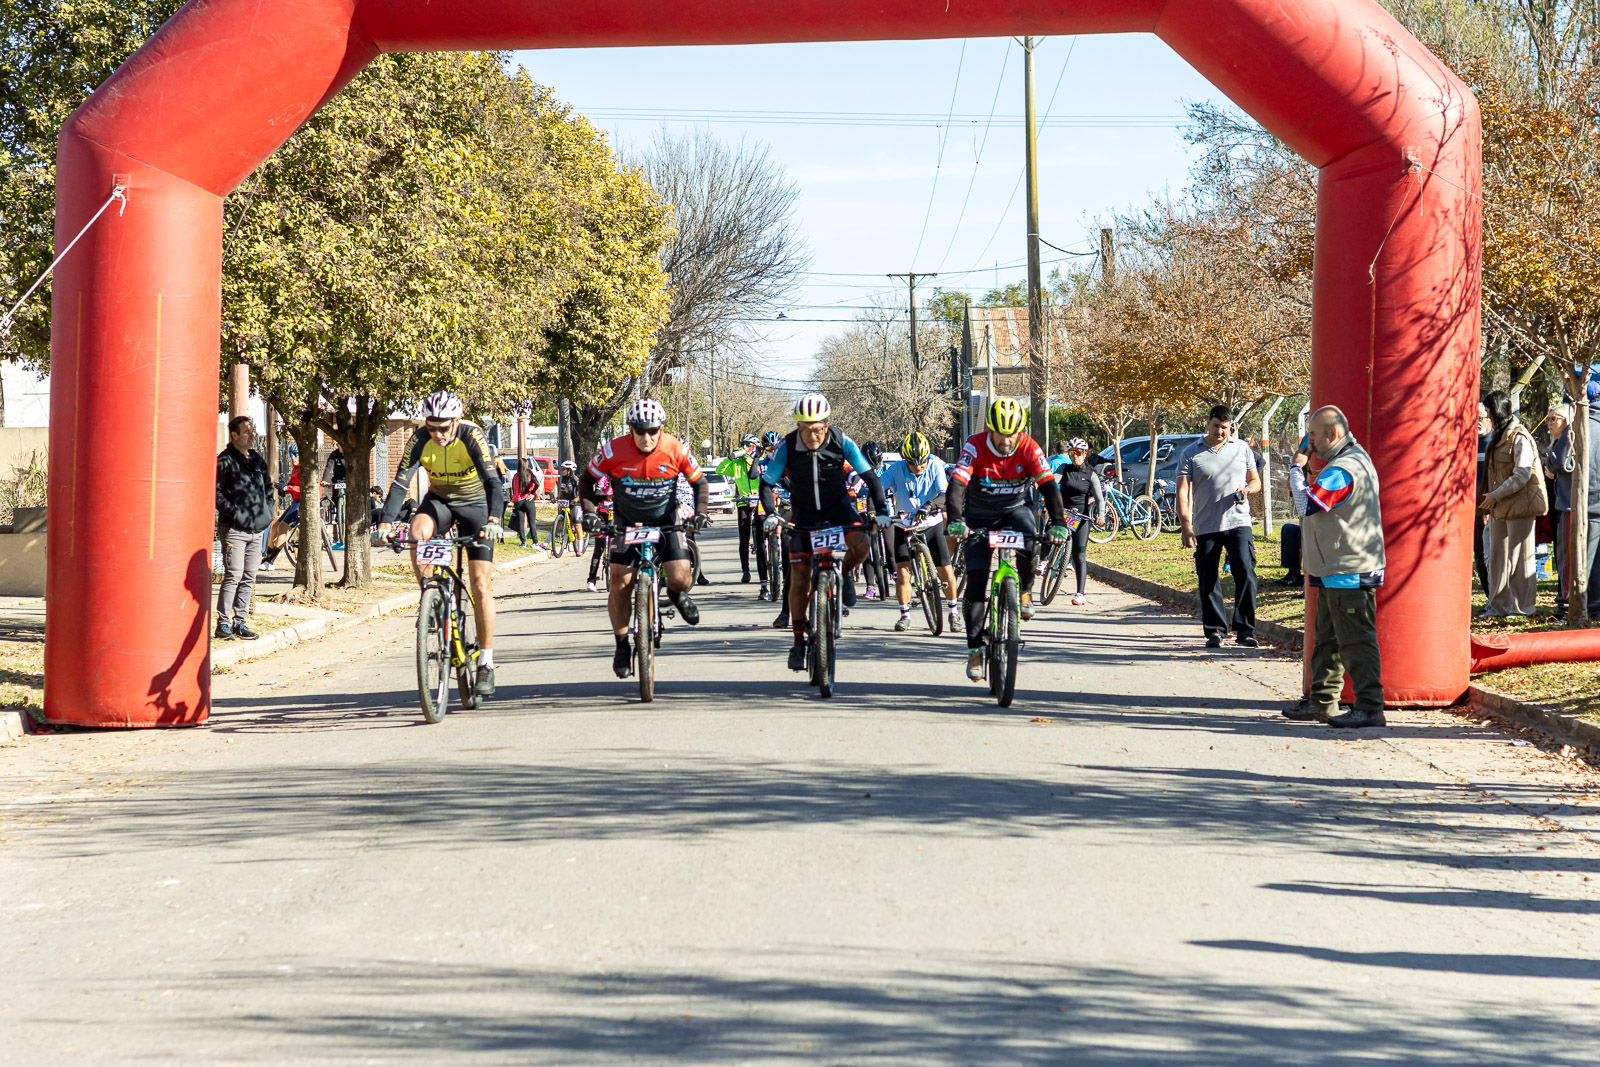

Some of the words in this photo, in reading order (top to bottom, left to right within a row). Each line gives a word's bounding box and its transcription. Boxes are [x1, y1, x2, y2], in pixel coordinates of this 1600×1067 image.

[401, 434, 419, 469] MAXIBIKE
[634, 531, 650, 539] 13
[814, 533, 840, 548] 213
[996, 535, 1018, 544] 30
[423, 546, 446, 558] 65
